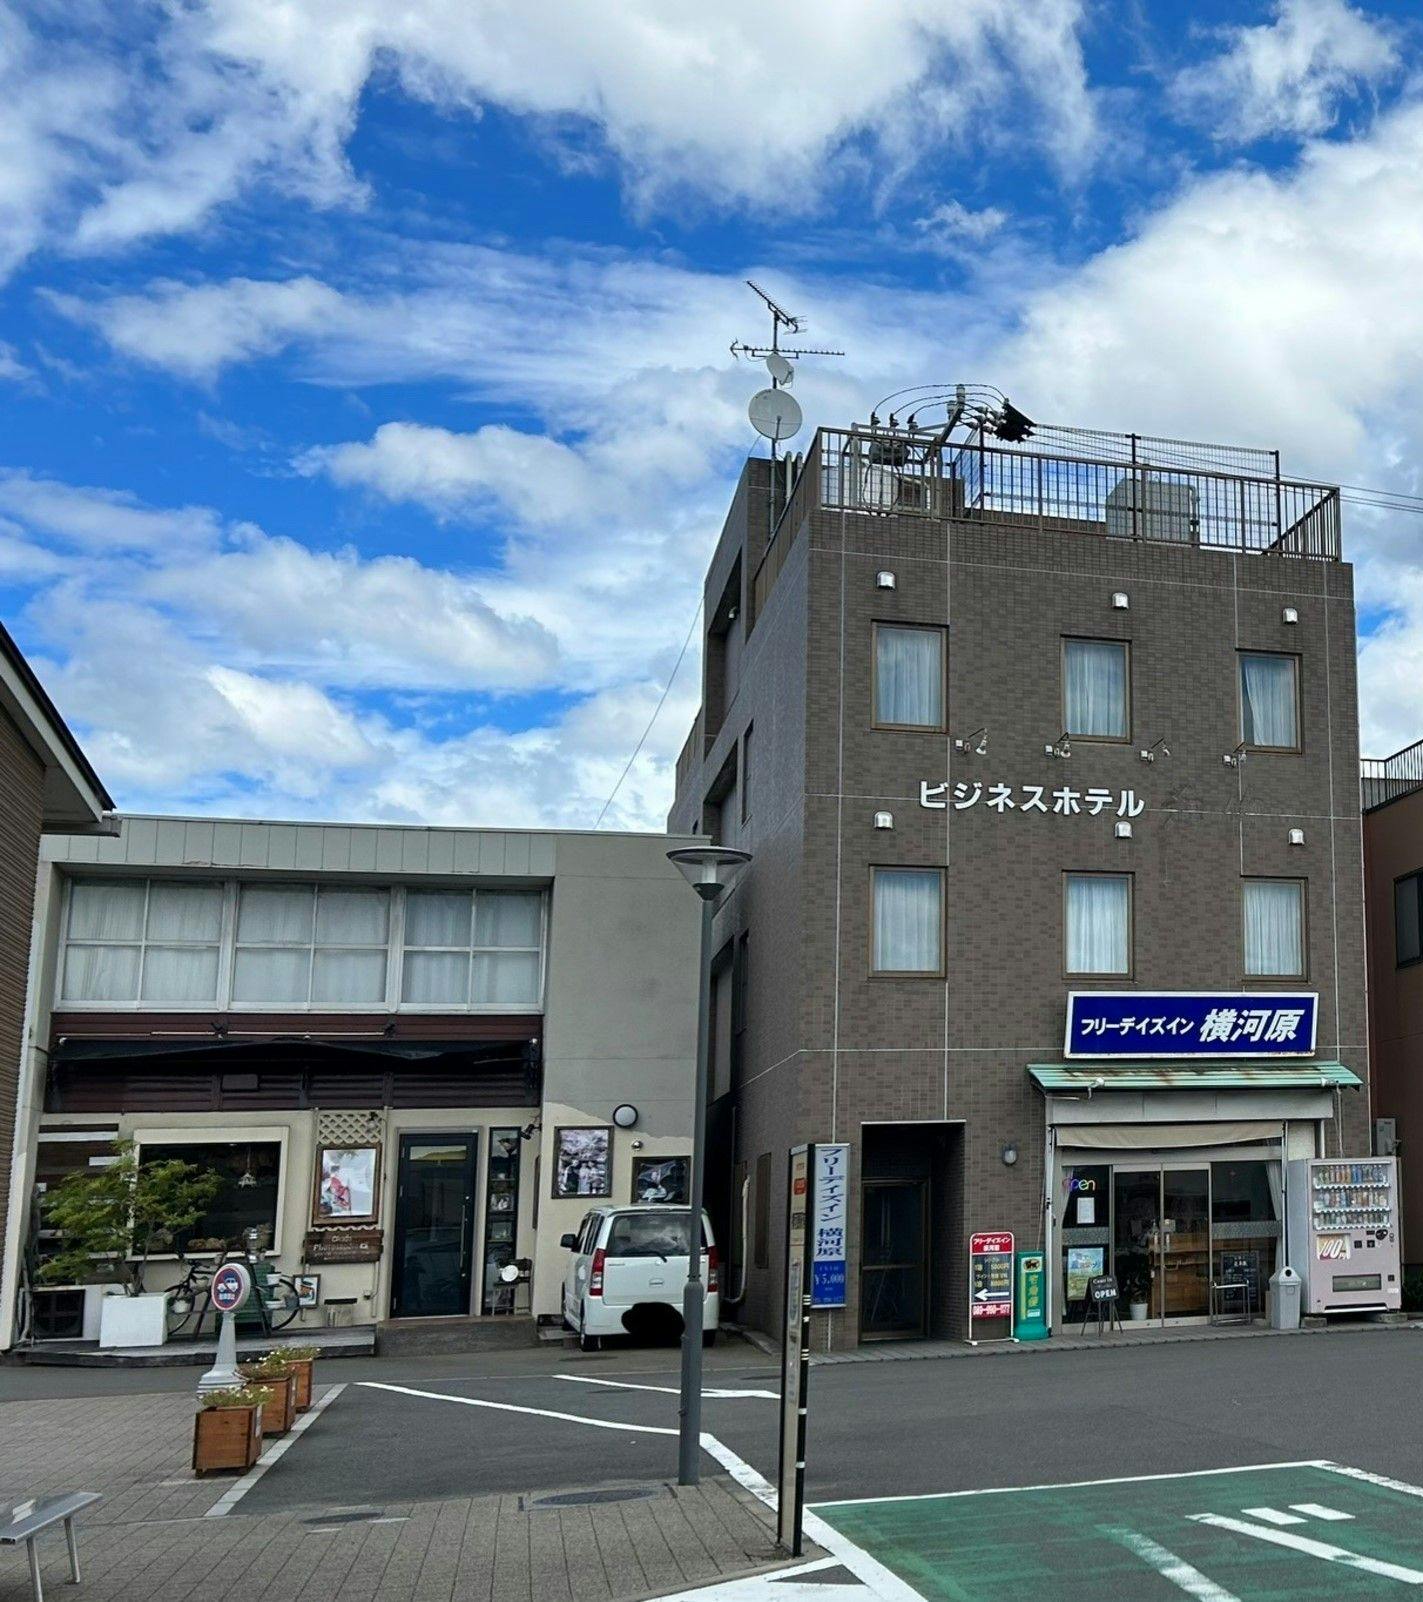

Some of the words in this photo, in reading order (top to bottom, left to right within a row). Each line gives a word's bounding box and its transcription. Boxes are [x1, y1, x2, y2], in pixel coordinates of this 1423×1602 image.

[920, 780, 1145, 817] ビジネスホテル
[1081, 1016, 1195, 1036] フリーデイズイン
[1199, 1008, 1306, 1043] 横河原
[1094, 1288, 1117, 1299] OPEN
